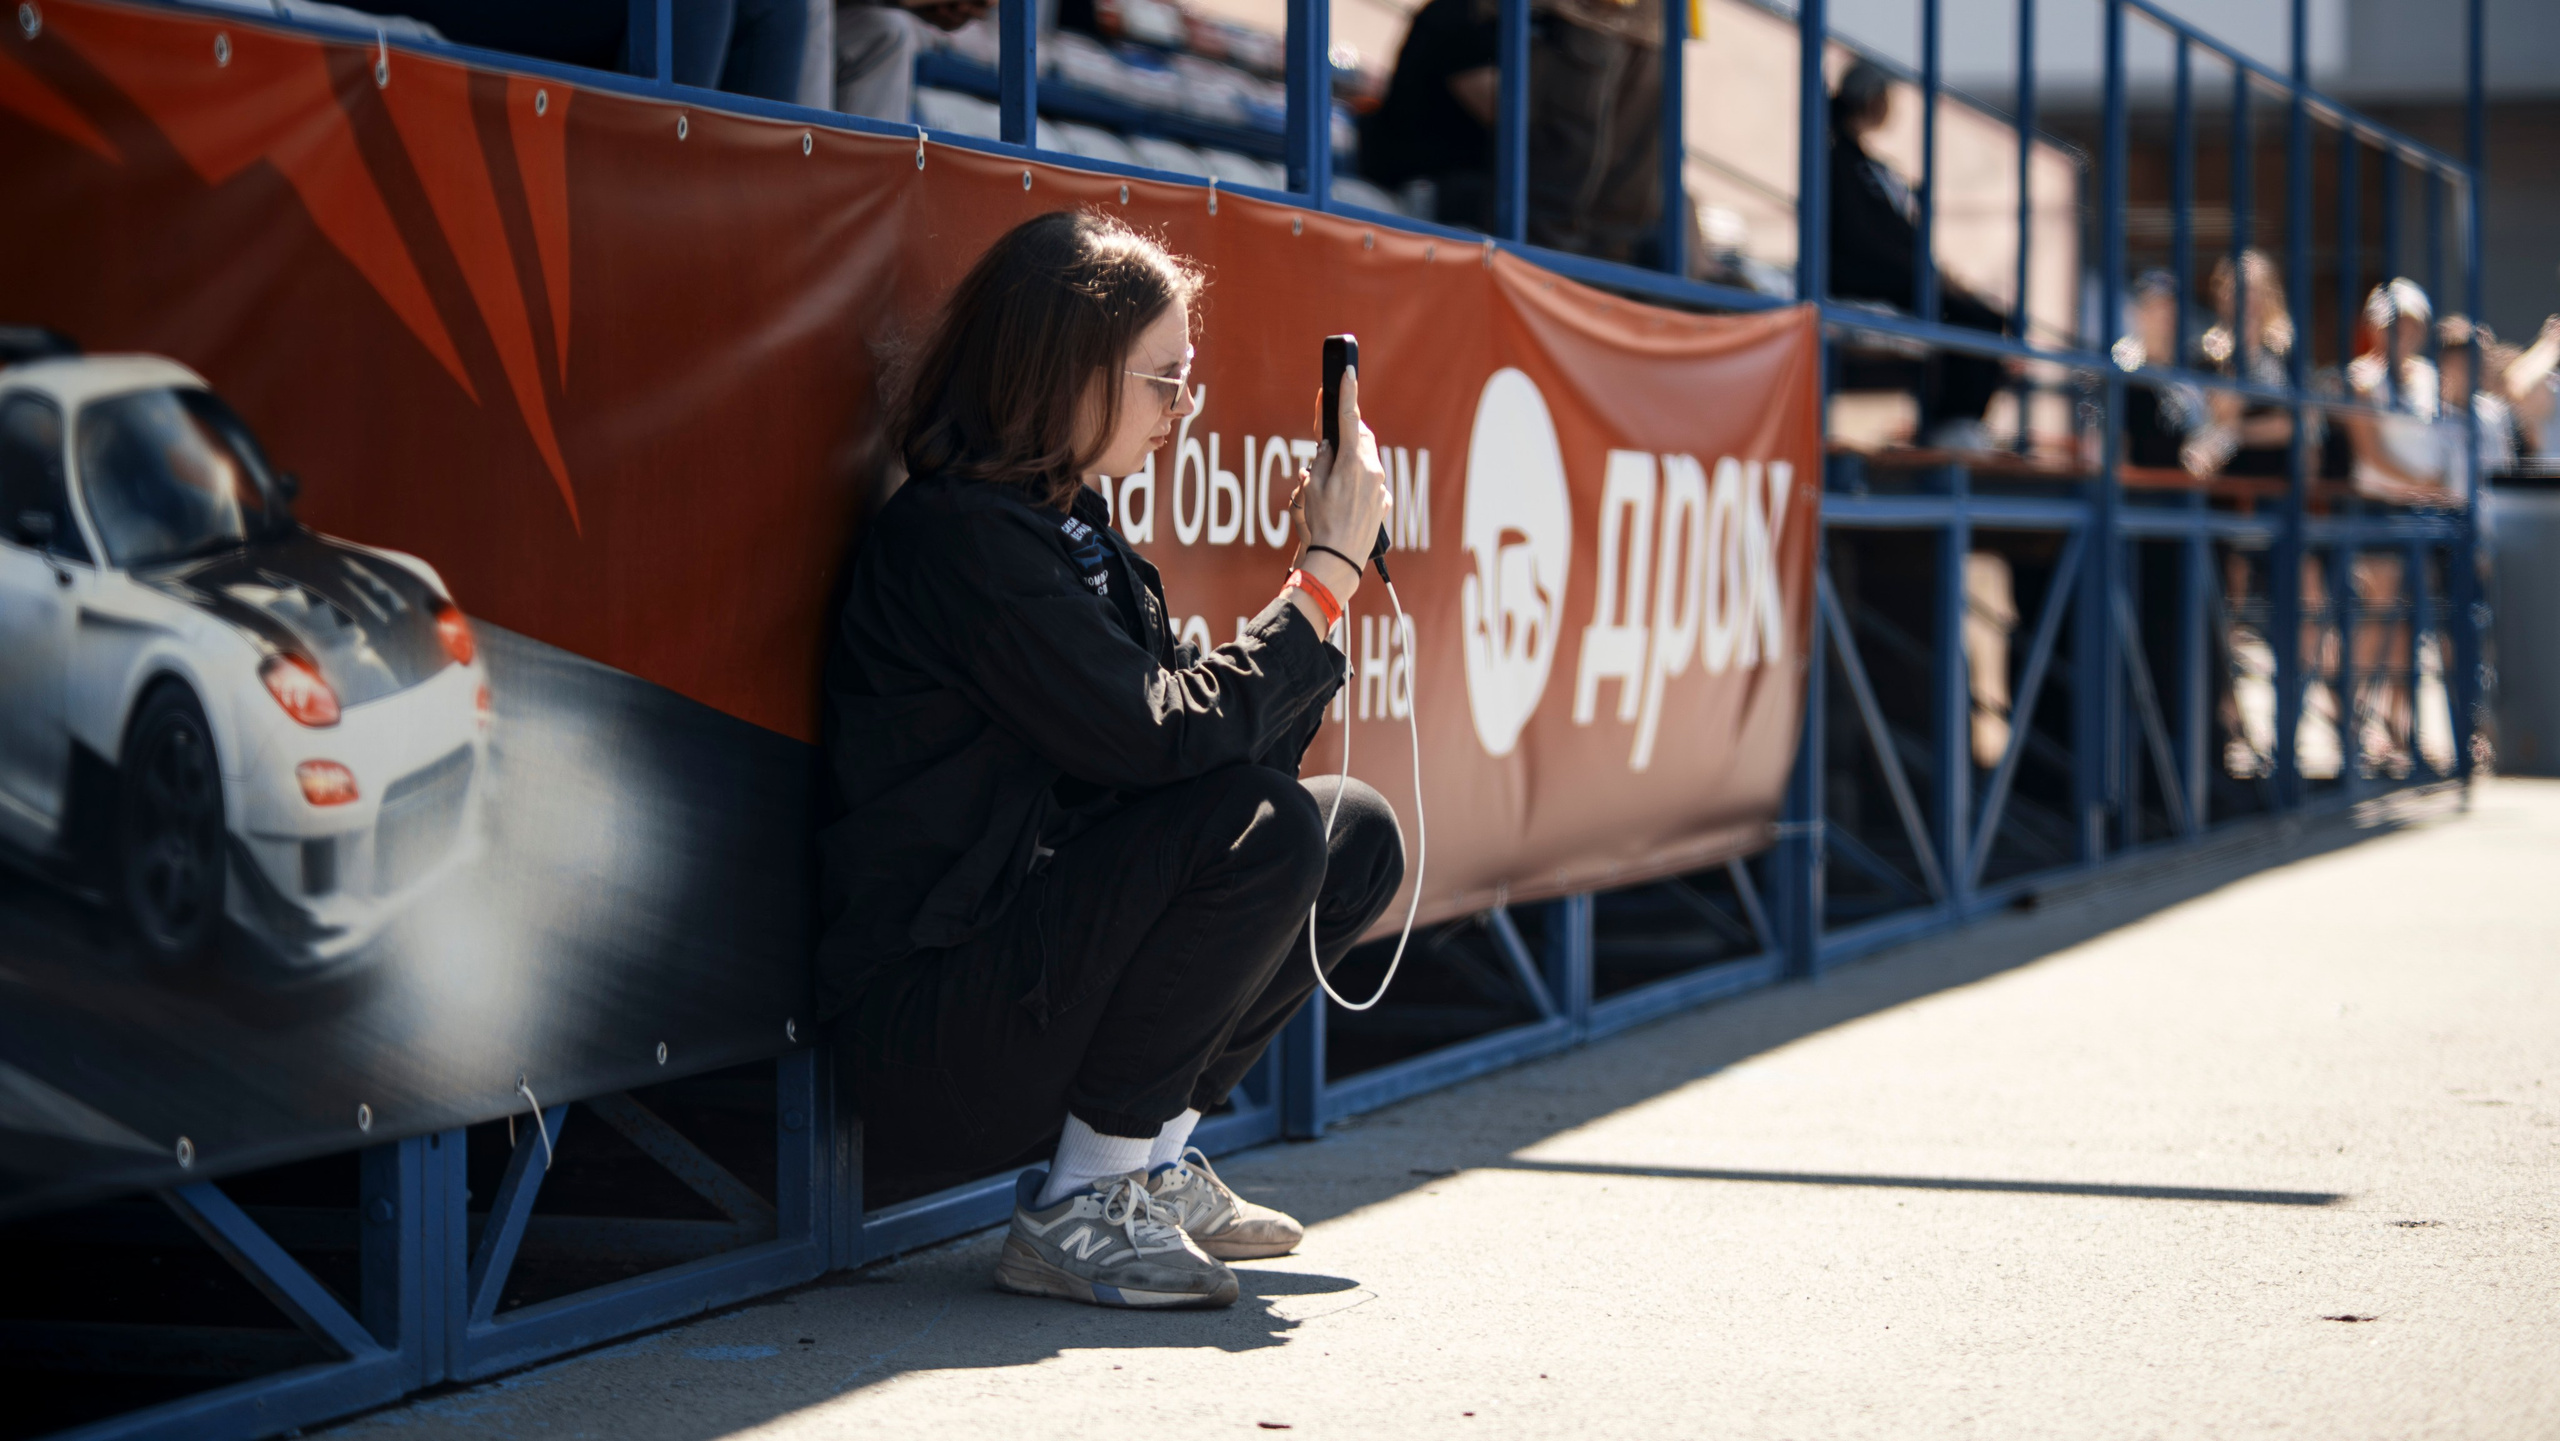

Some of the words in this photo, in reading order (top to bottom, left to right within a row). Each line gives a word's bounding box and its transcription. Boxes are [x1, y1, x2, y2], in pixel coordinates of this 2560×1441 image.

[1100, 446, 1156, 546] а
[1358, 612, 1417, 722] на
[1060, 1223, 1114, 1261] N
